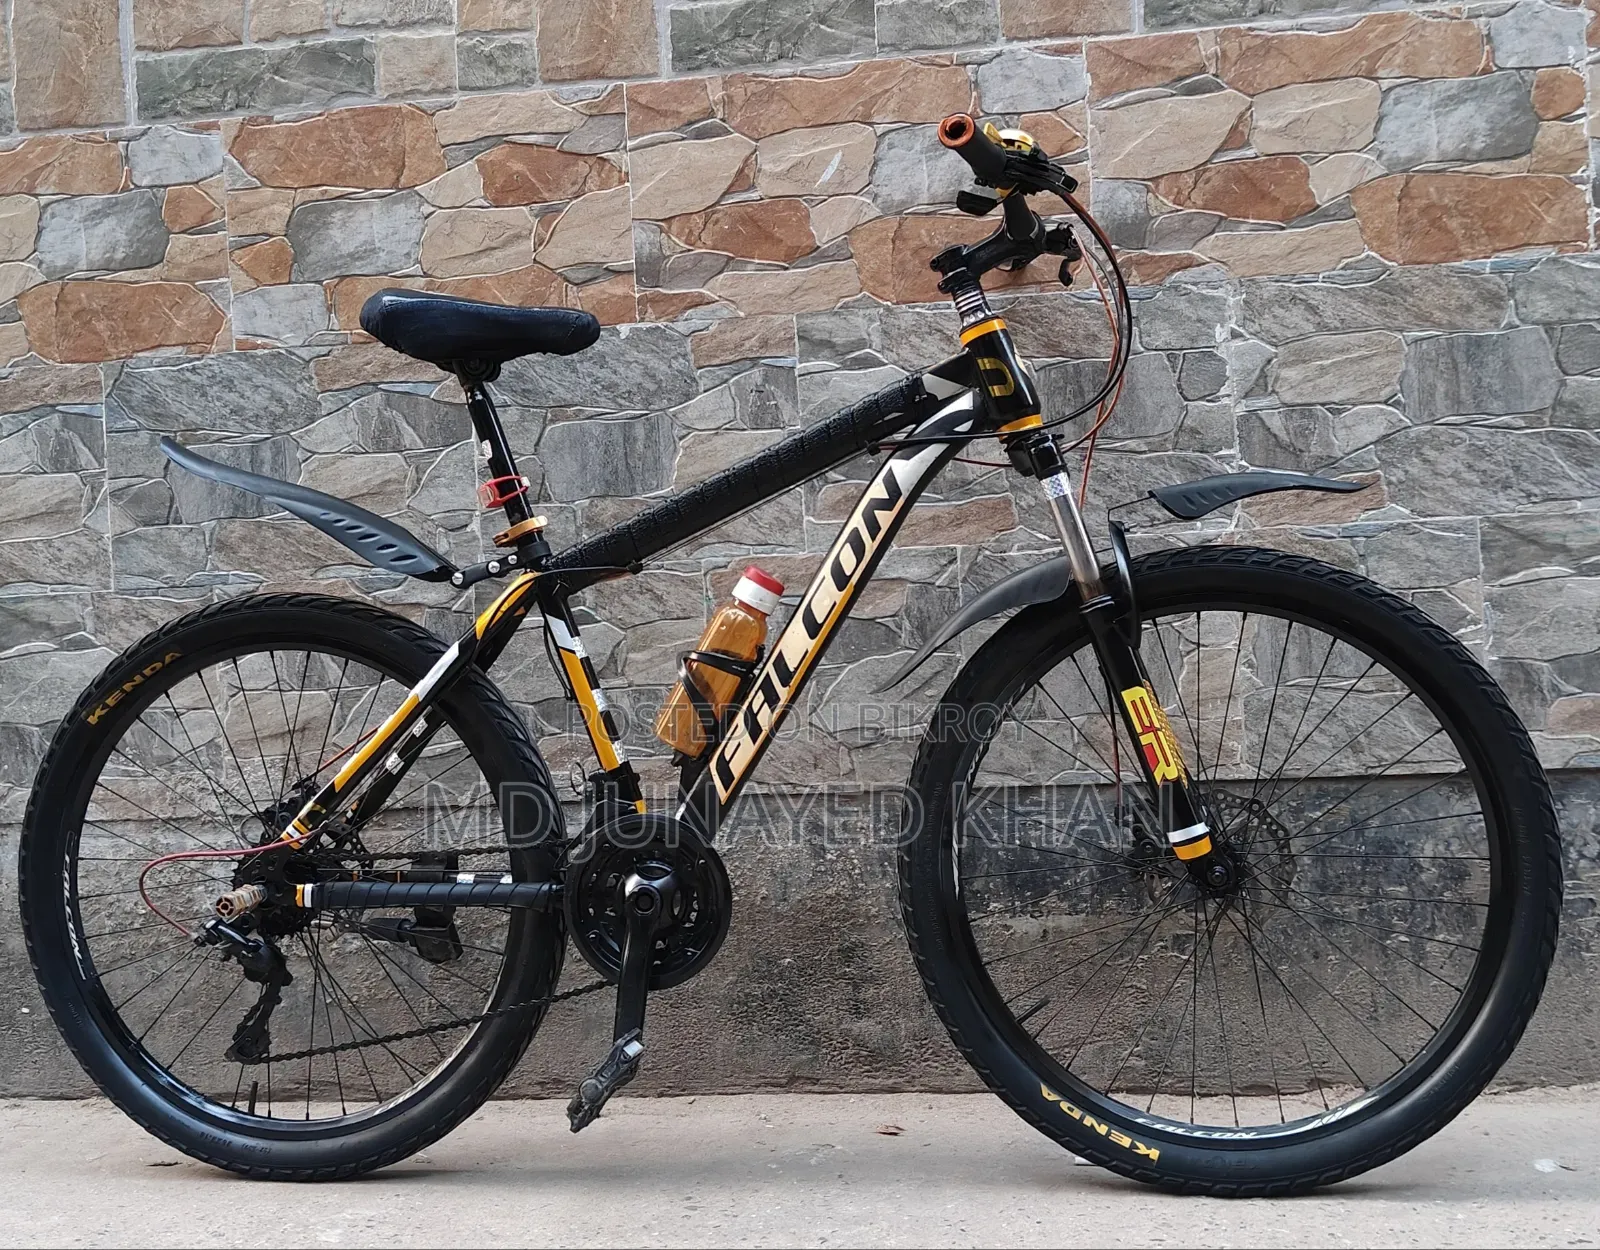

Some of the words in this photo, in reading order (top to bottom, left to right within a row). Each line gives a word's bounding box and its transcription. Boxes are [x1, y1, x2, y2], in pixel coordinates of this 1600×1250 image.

[716, 466, 902, 792] FALCON
[87, 652, 182, 725] KENDA
[63, 854, 83, 961] FALCON
[1040, 1082, 1161, 1166] KENDA
[1134, 1117, 1258, 1139] FALCON
